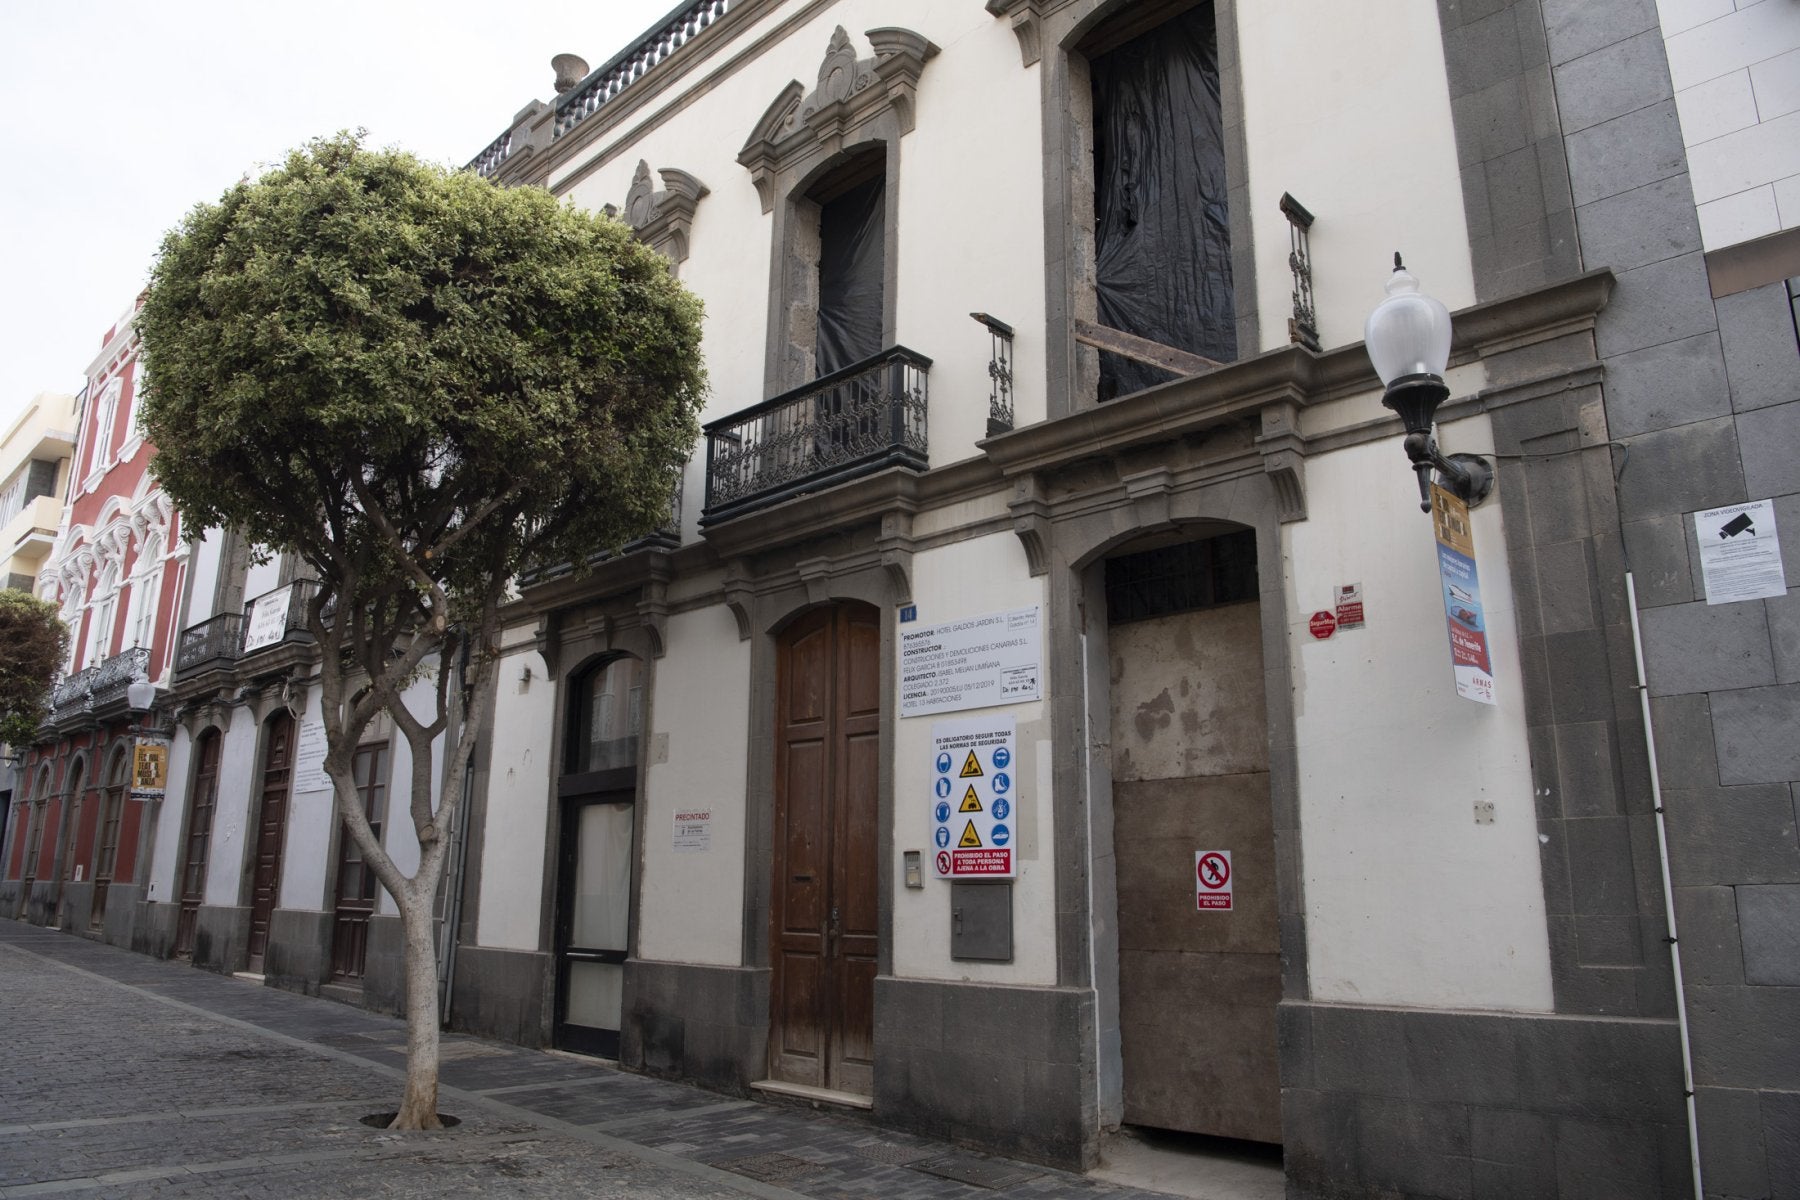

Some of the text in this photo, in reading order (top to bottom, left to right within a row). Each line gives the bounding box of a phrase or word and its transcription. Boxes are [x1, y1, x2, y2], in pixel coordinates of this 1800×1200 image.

[1704, 503, 1763, 518] ZONA VIDEOVIGILADA
[1338, 604, 1362, 613] Alarma
[937, 626, 951, 635] HOTEL
[976, 617, 995, 627] JARDIN
[950, 644, 989, 658] DEMOLICIONES
[990, 639, 1018, 650] CANARIAS
[1464, 639, 1482, 653] Tenerife
[916, 663, 935, 672] GARCIA
[903, 680, 933, 691] COLEGIADO
[1472, 677, 1492, 689] ARMAS
[943, 734, 974, 743] OBLIGATORIO
[975, 732, 994, 740] SEGUIR
[978, 738, 1007, 746] SEGURIDAD
[675, 812, 710, 821] PRECINTADO
